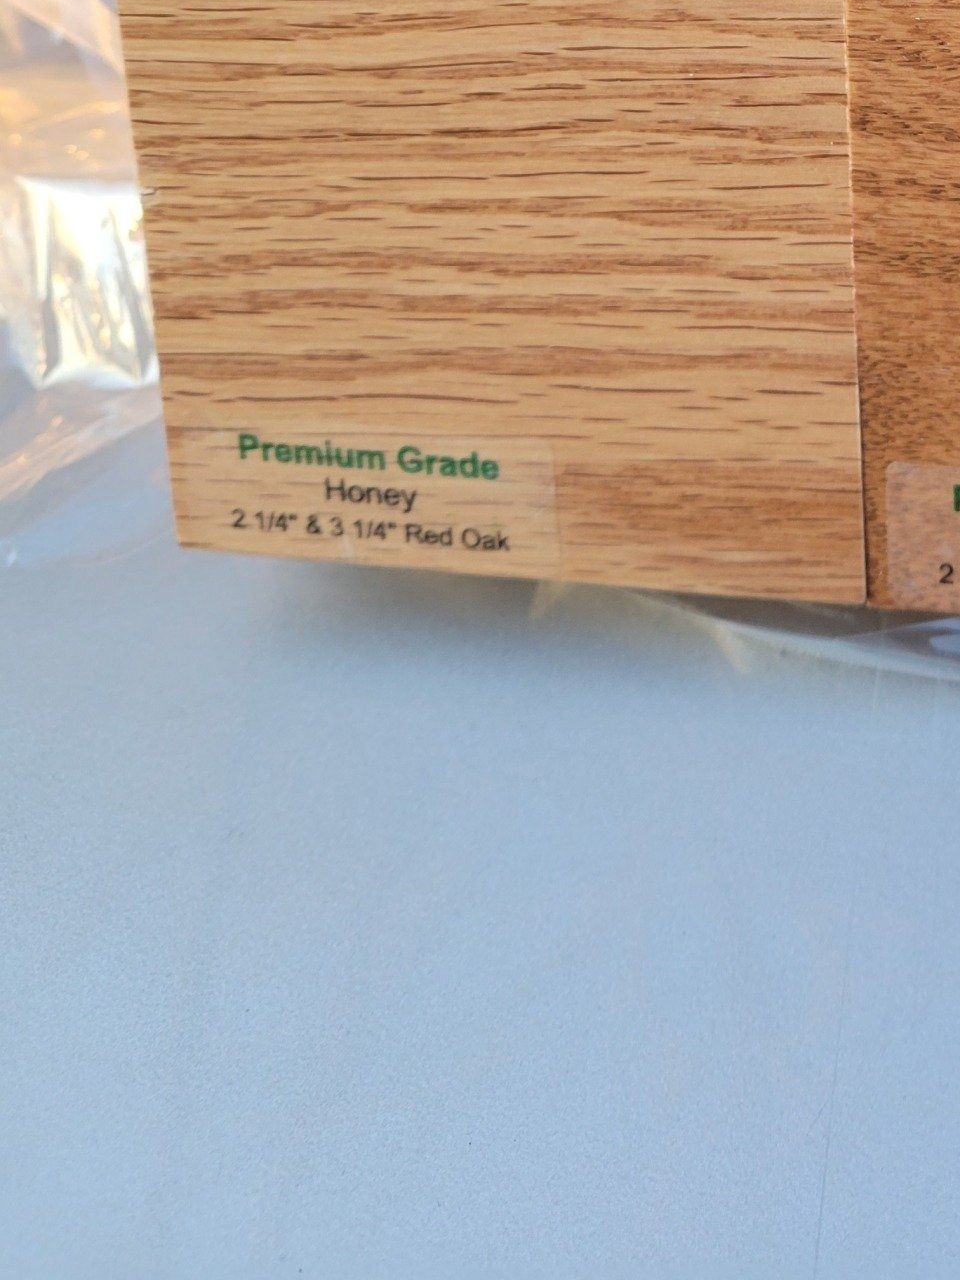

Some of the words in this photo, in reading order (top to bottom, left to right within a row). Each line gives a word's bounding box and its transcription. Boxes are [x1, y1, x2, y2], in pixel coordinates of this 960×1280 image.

[237, 433, 386, 470] Premium
[396, 445, 500, 480] Grade
[325, 478, 418, 513] Honey
[231, 509, 246, 528] 2
[255, 512, 298, 534] 1/4"
[306, 515, 322, 536] &
[330, 517, 344, 537] 3
[353, 519, 397, 541] 1/4"
[405, 524, 453, 548] Red
[461, 528, 511, 552] Oak
[939, 564, 954, 585] 2
